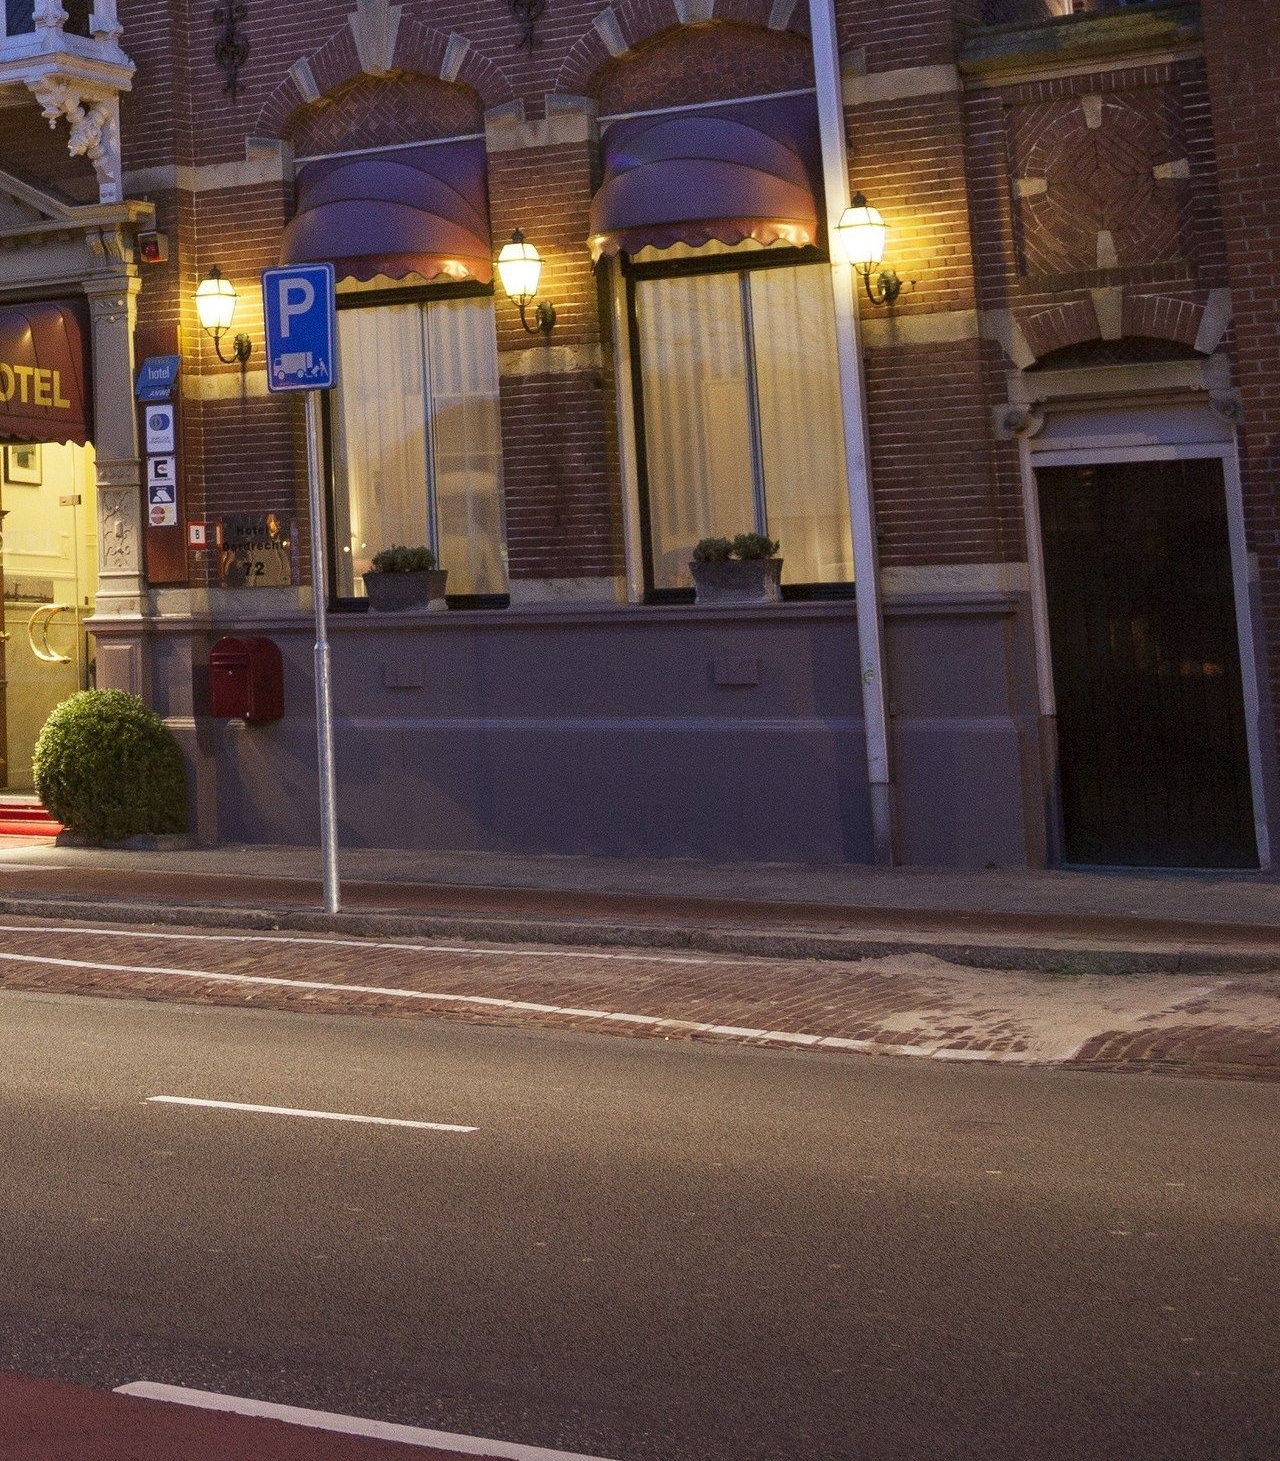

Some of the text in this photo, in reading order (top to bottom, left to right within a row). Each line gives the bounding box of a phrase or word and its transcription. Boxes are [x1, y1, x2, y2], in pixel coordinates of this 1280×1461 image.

[278, 277, 315, 338] P
[148, 366, 170, 380] hotel
[243, 561, 265, 576] 72
